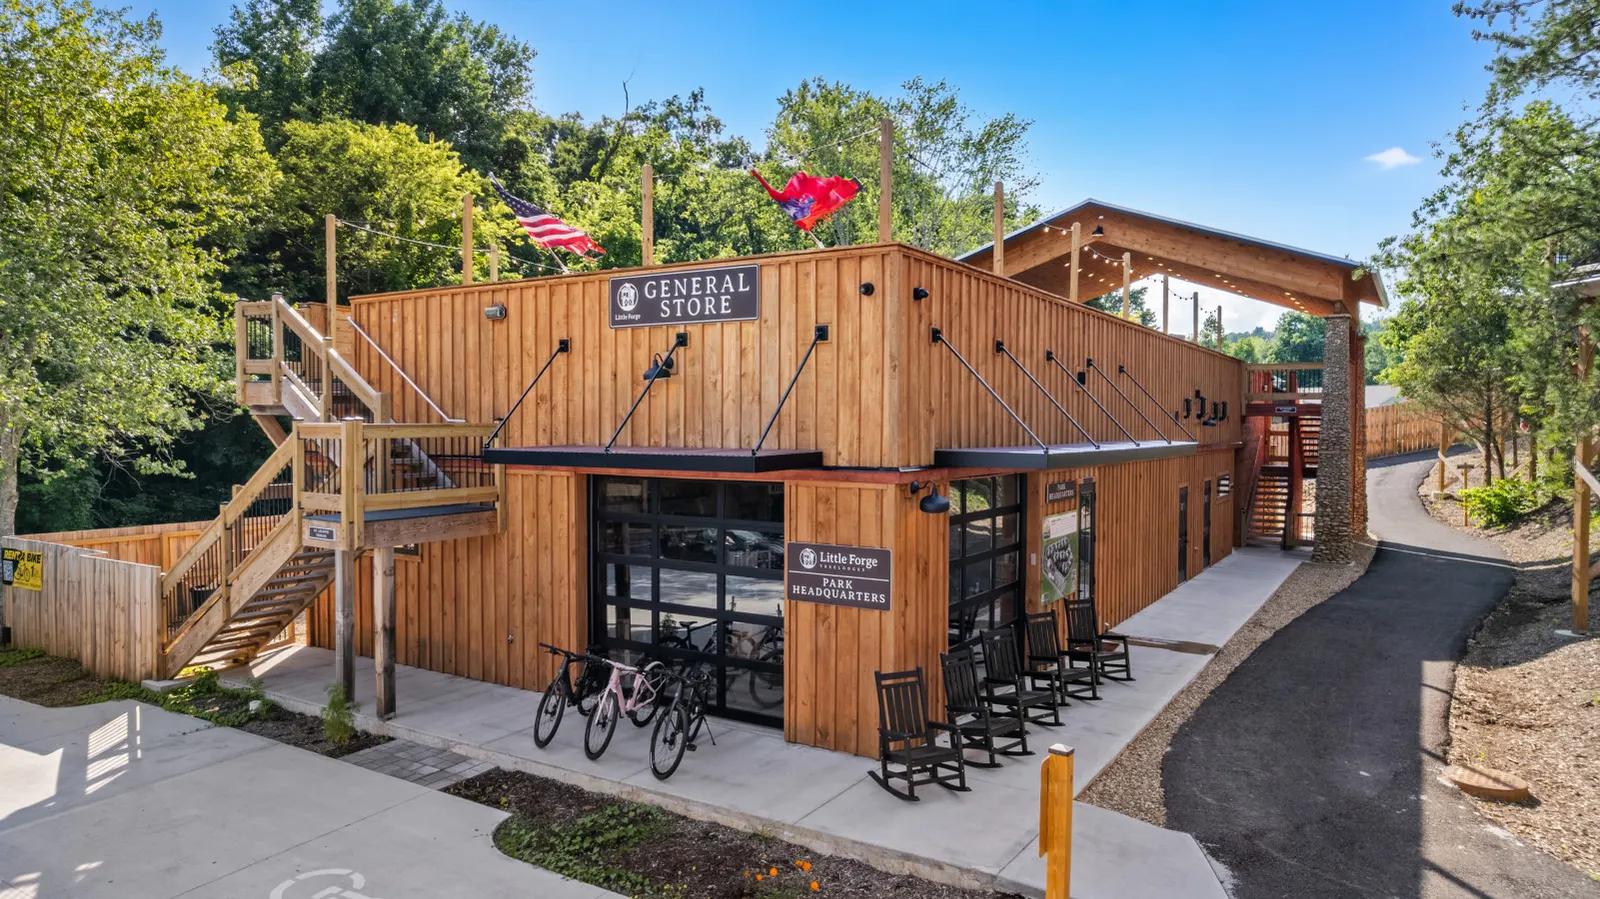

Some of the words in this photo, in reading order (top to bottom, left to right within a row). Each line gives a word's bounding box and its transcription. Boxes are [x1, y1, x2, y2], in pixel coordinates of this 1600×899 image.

[644, 273, 750, 299] GENERAL
[660, 295, 732, 318] STORE
[615, 313, 628, 321] Little
[628, 313, 641, 321] Forge
[4, 549, 20, 560] RENT
[27, 553, 41, 564] BIKE
[820, 552, 847, 564] Little
[849, 554, 878, 569] Forge
[820, 564, 865, 572] TREELODGES
[823, 577, 853, 590] PARK
[792, 585, 886, 603] HEADQUARTERS
